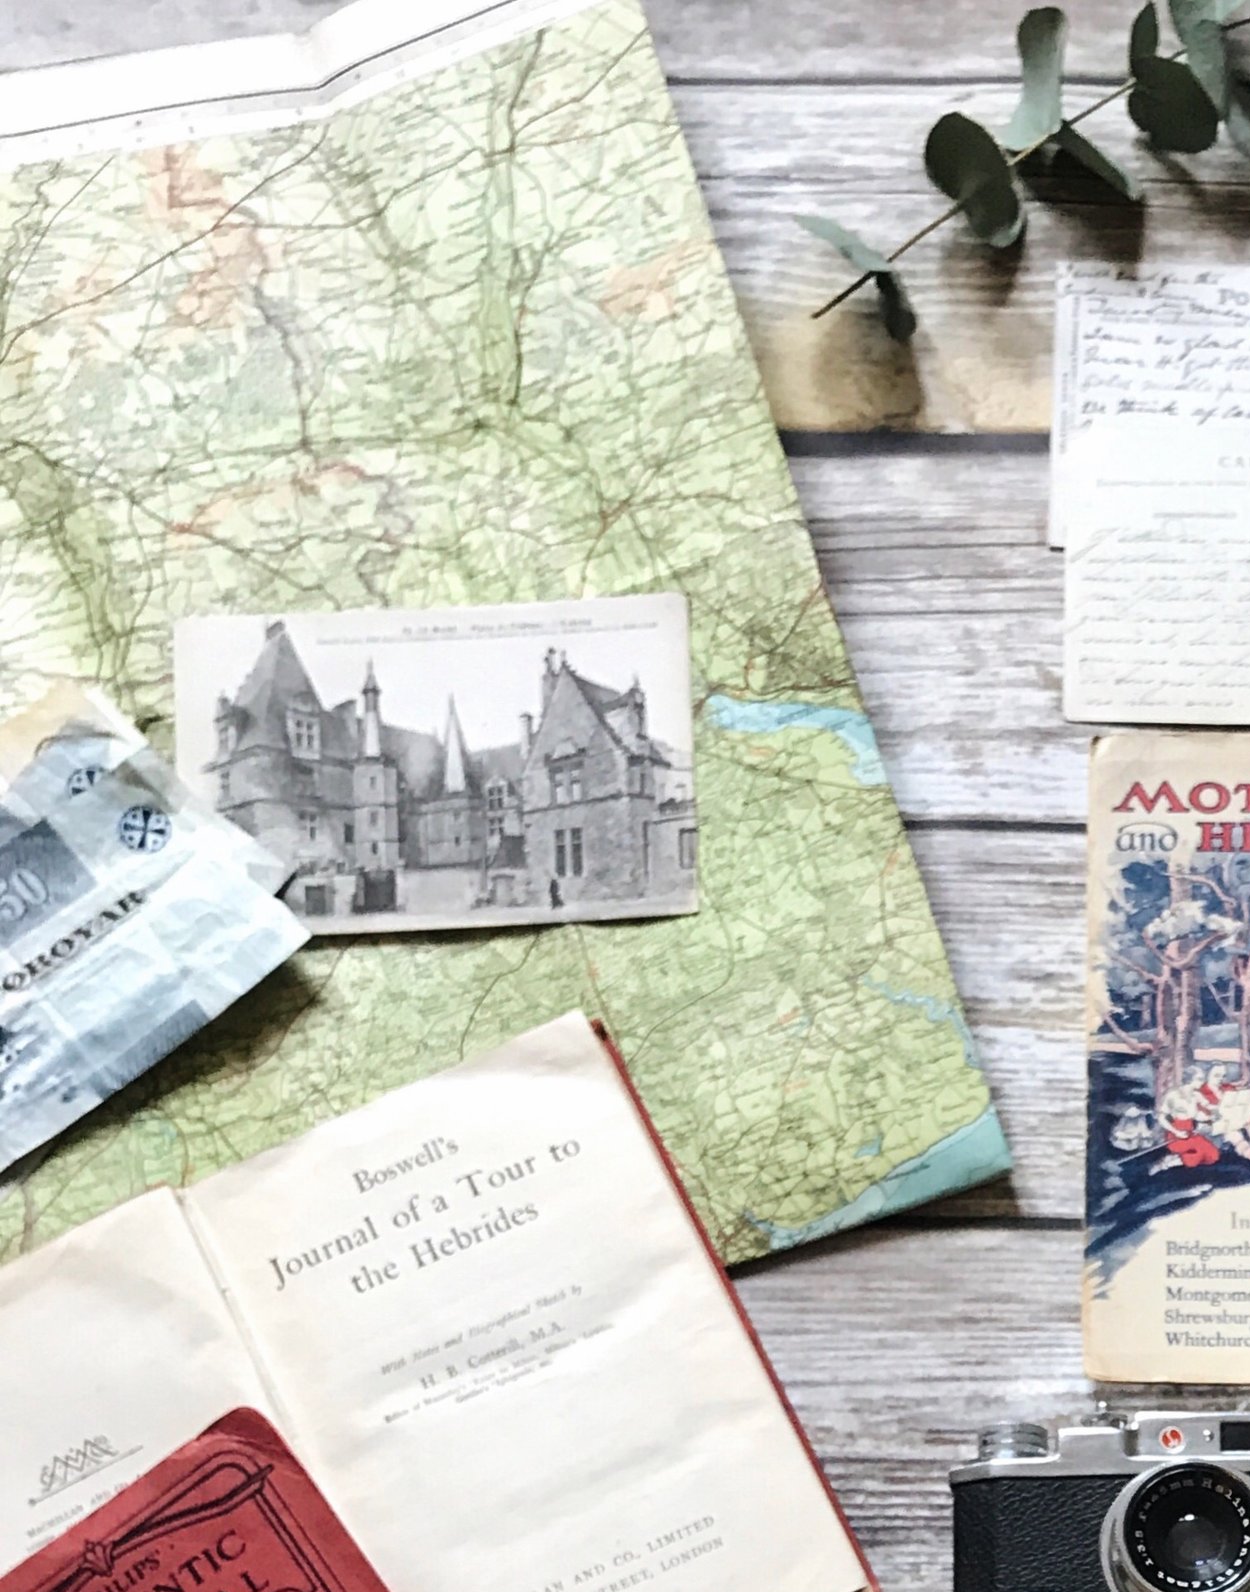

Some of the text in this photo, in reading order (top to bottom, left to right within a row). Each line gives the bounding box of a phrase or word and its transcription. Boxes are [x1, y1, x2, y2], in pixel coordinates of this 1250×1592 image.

[1115, 821, 1179, 853] and
[352, 1136, 460, 1193] Boswell's
[268, 1137, 582, 1292] Journal of a Tour to
[350, 1200, 541, 1295] the Hebrides
[573, 1563, 606, 1585] AND
[646, 1514, 716, 1553] LIMITED
[660, 1536, 725, 1573] LONDON
